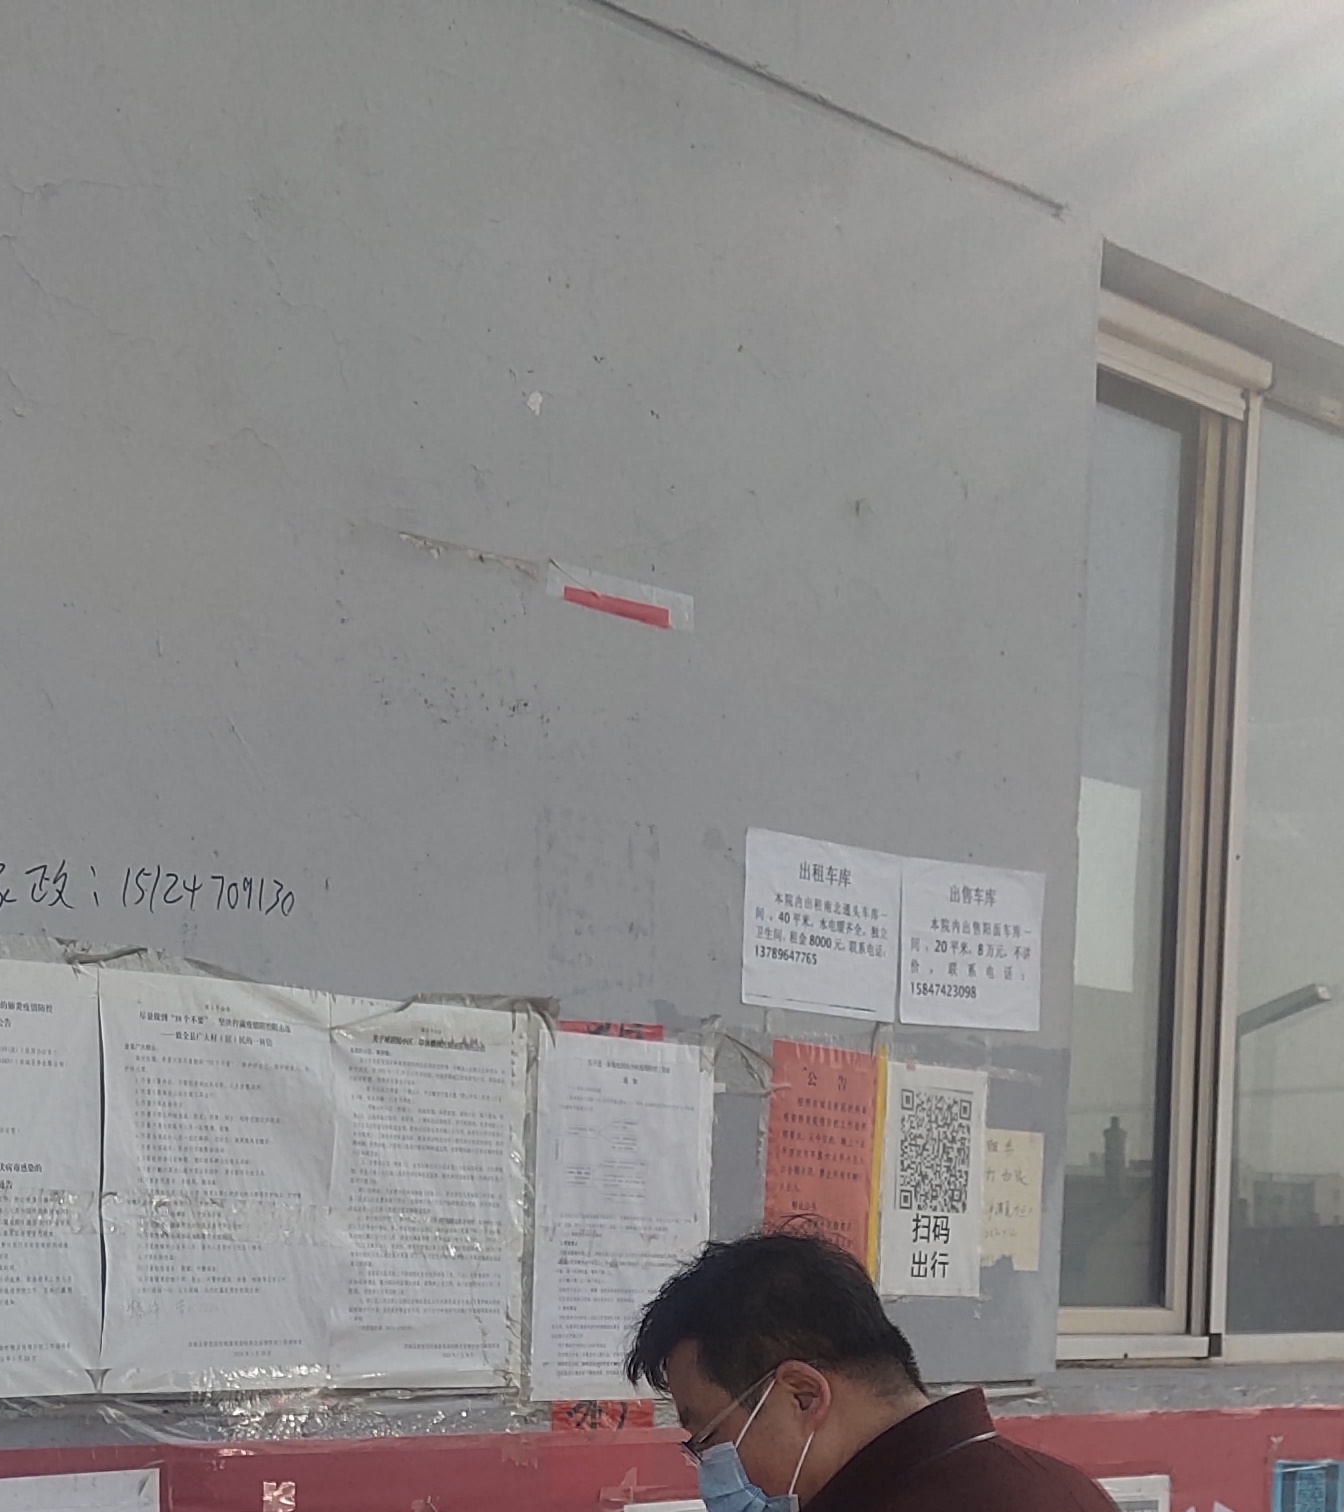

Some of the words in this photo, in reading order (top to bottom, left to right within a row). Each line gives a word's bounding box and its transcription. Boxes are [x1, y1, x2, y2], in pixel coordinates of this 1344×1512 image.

[799, 860, 851, 887] 出租车库
[949, 884, 997, 907] 出售车库
[755, 945, 818, 965] 13789647765
[910, 982, 977, 998] 15847423098
[912, 1213, 950, 1244] 扫码
[910, 1250, 949, 1278] 出行
